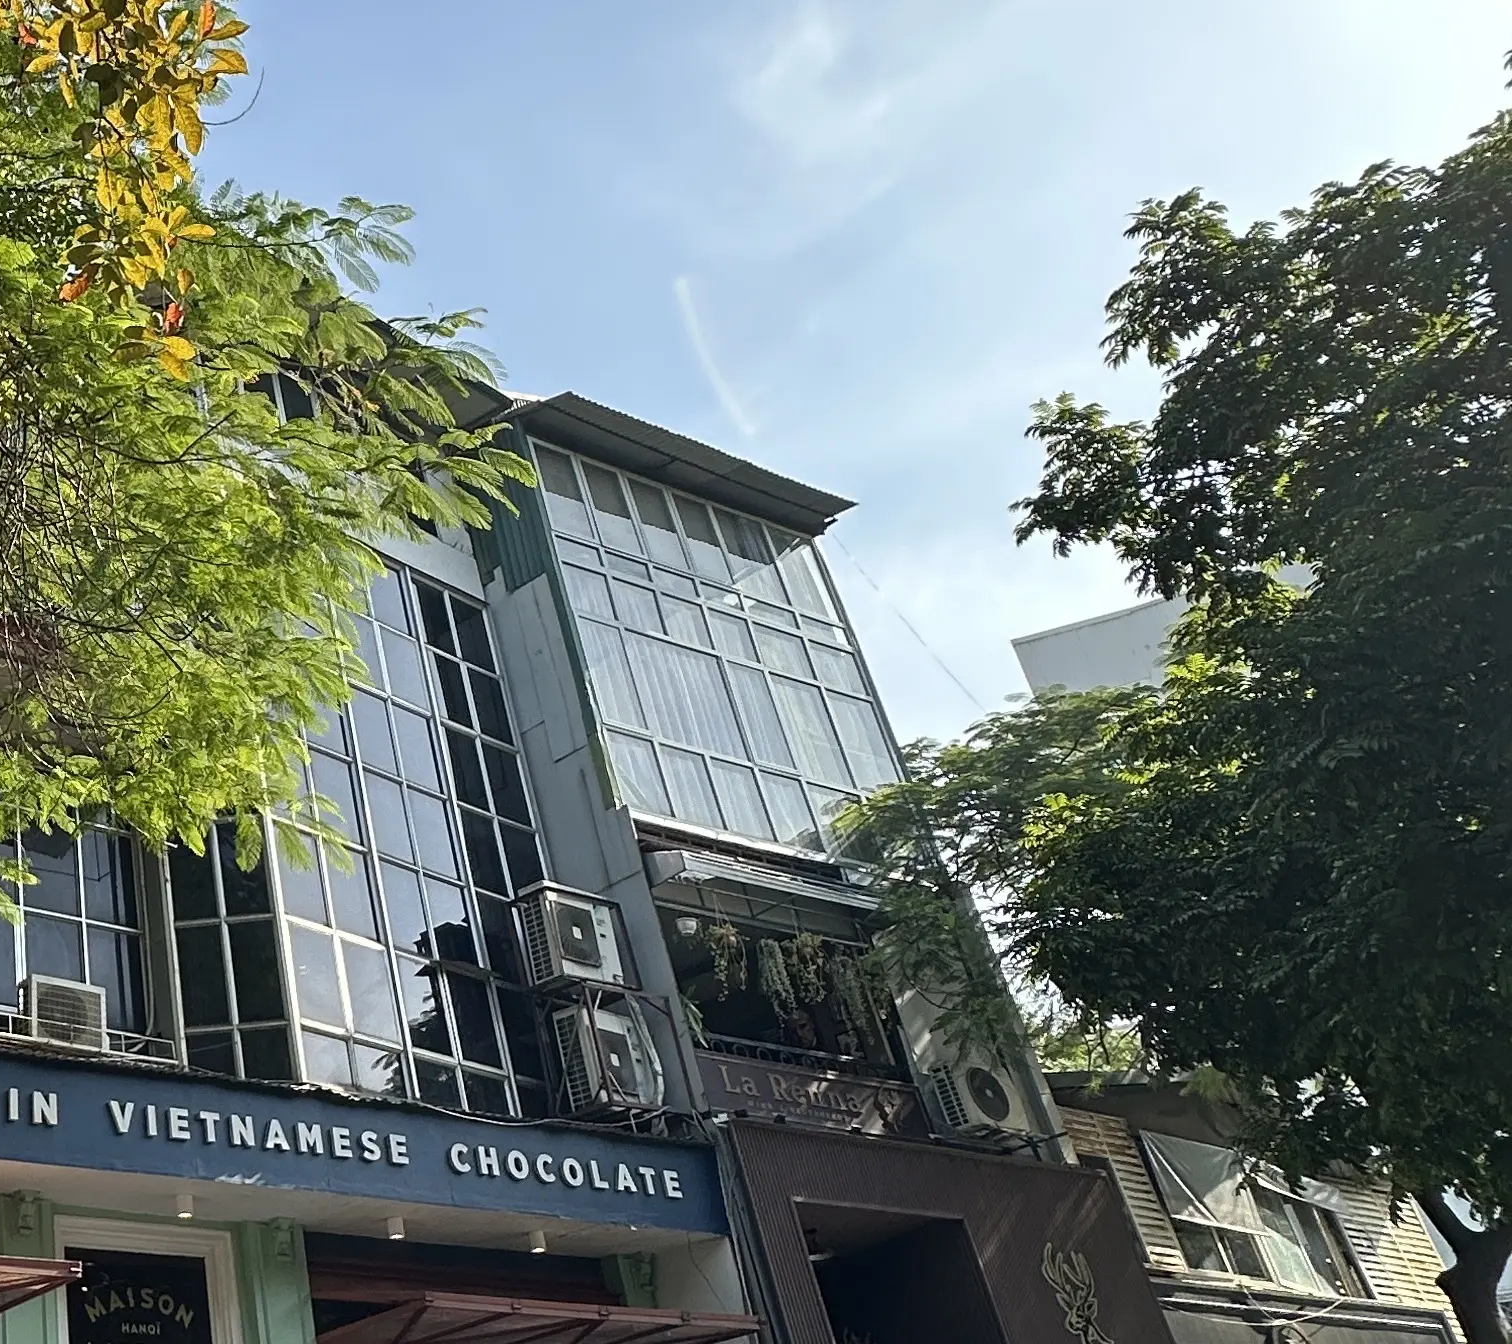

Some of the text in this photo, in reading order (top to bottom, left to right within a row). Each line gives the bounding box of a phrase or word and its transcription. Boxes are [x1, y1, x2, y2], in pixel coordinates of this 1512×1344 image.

[718, 1064, 760, 1097] La
[108, 1099, 410, 1165] VIETNAMESE
[449, 1143, 683, 1199] CHOCOLATE
[84, 1287, 194, 1329] MAISON
